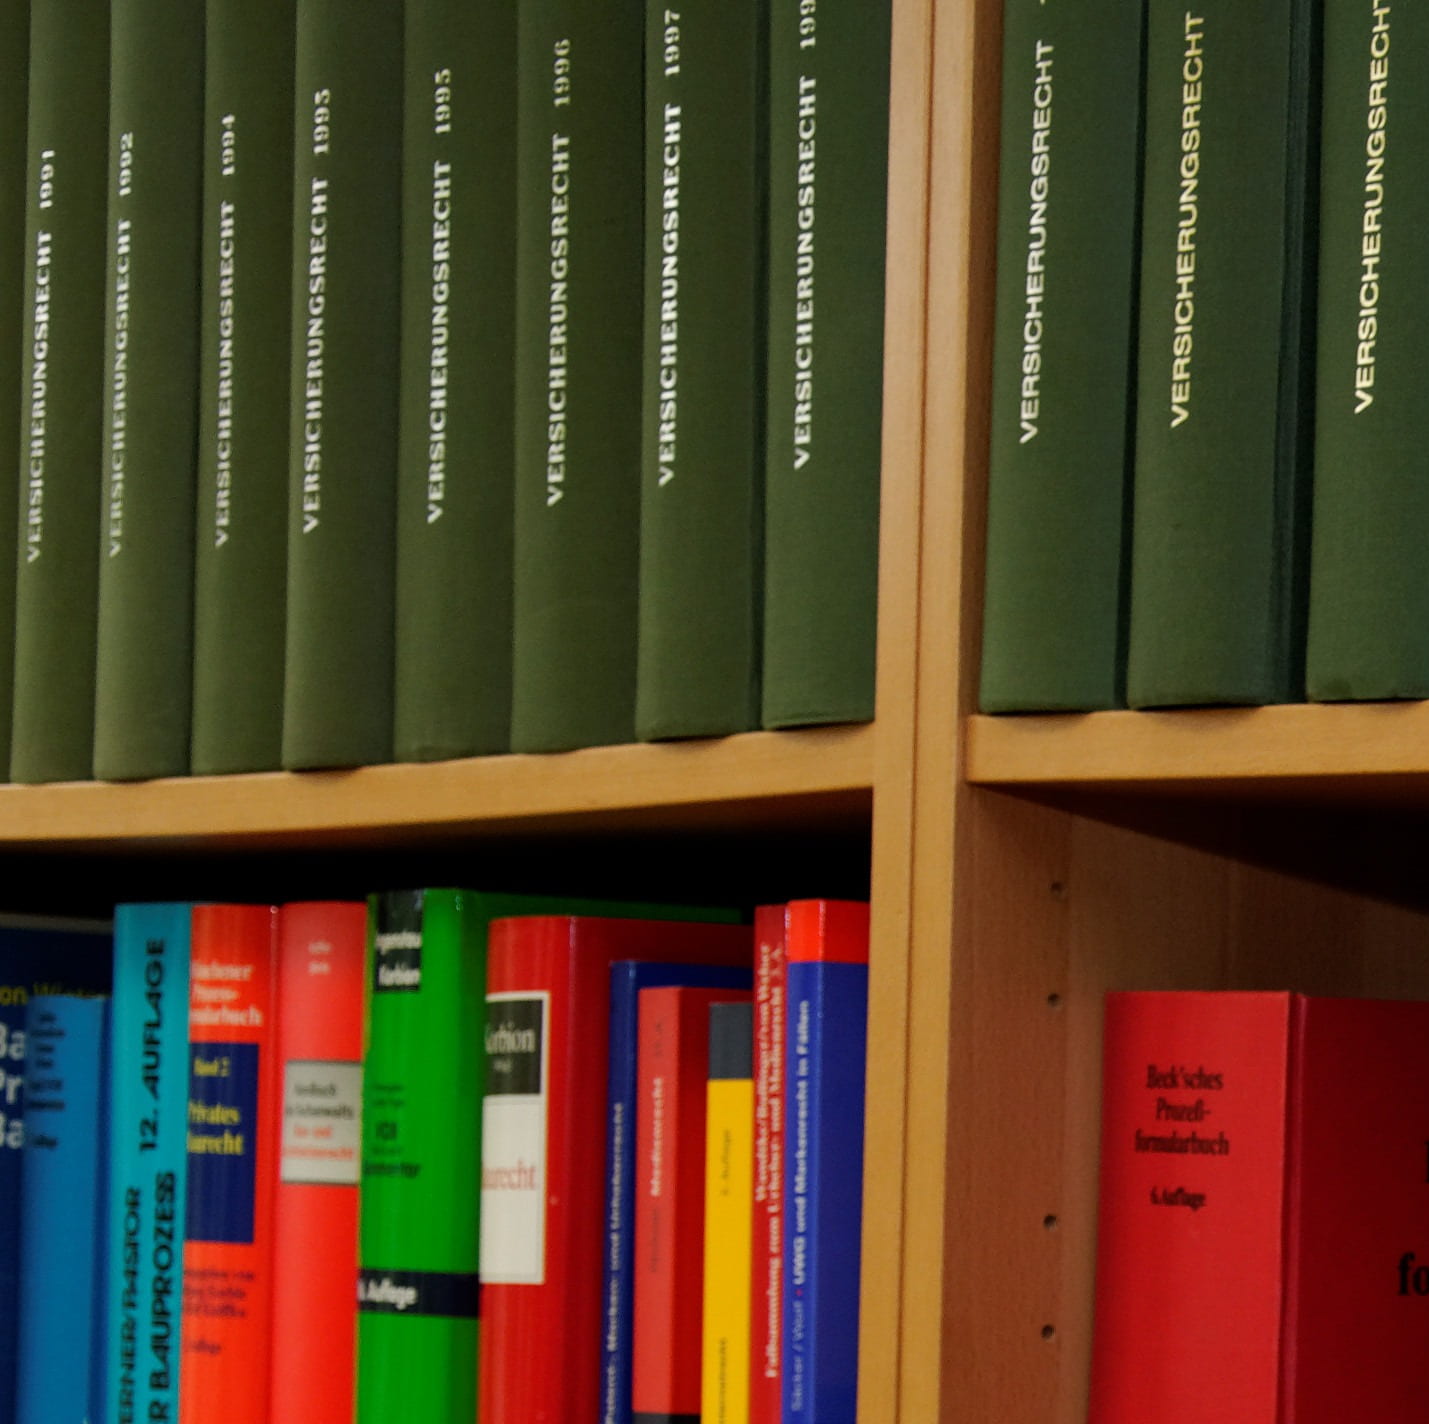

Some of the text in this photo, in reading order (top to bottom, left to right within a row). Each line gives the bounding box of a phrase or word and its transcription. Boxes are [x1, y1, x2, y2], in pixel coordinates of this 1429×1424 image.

[27, 148, 56, 563] VERSICHERUNGSRECHT 1991
[109, 132, 134, 558] VERSICHERUNGSRECHT 1992
[214, 115, 237, 547] VERSICHERUNGSRECHT 1994
[302, 177, 331, 534] VERSICHERUNGSRECHT
[427, 160, 452, 524] VERSICHERUNGSRECHT
[546, 39, 572, 507] VERSICHERUNGSRECHT 1996
[658, 9, 683, 487] VERSICHERUNGSRECHT 1997
[794, 75, 818, 470] VERSICHERUNGSRECHT
[1020, 40, 1055, 444] VERSICHERUNGSRECHT
[1171, 12, 1205, 429] VERSICHERUNGSRECHT
[138, 939, 166, 1153] 12. AUFLAGE
[149, 1170, 177, 1392] BAUPROZESS
